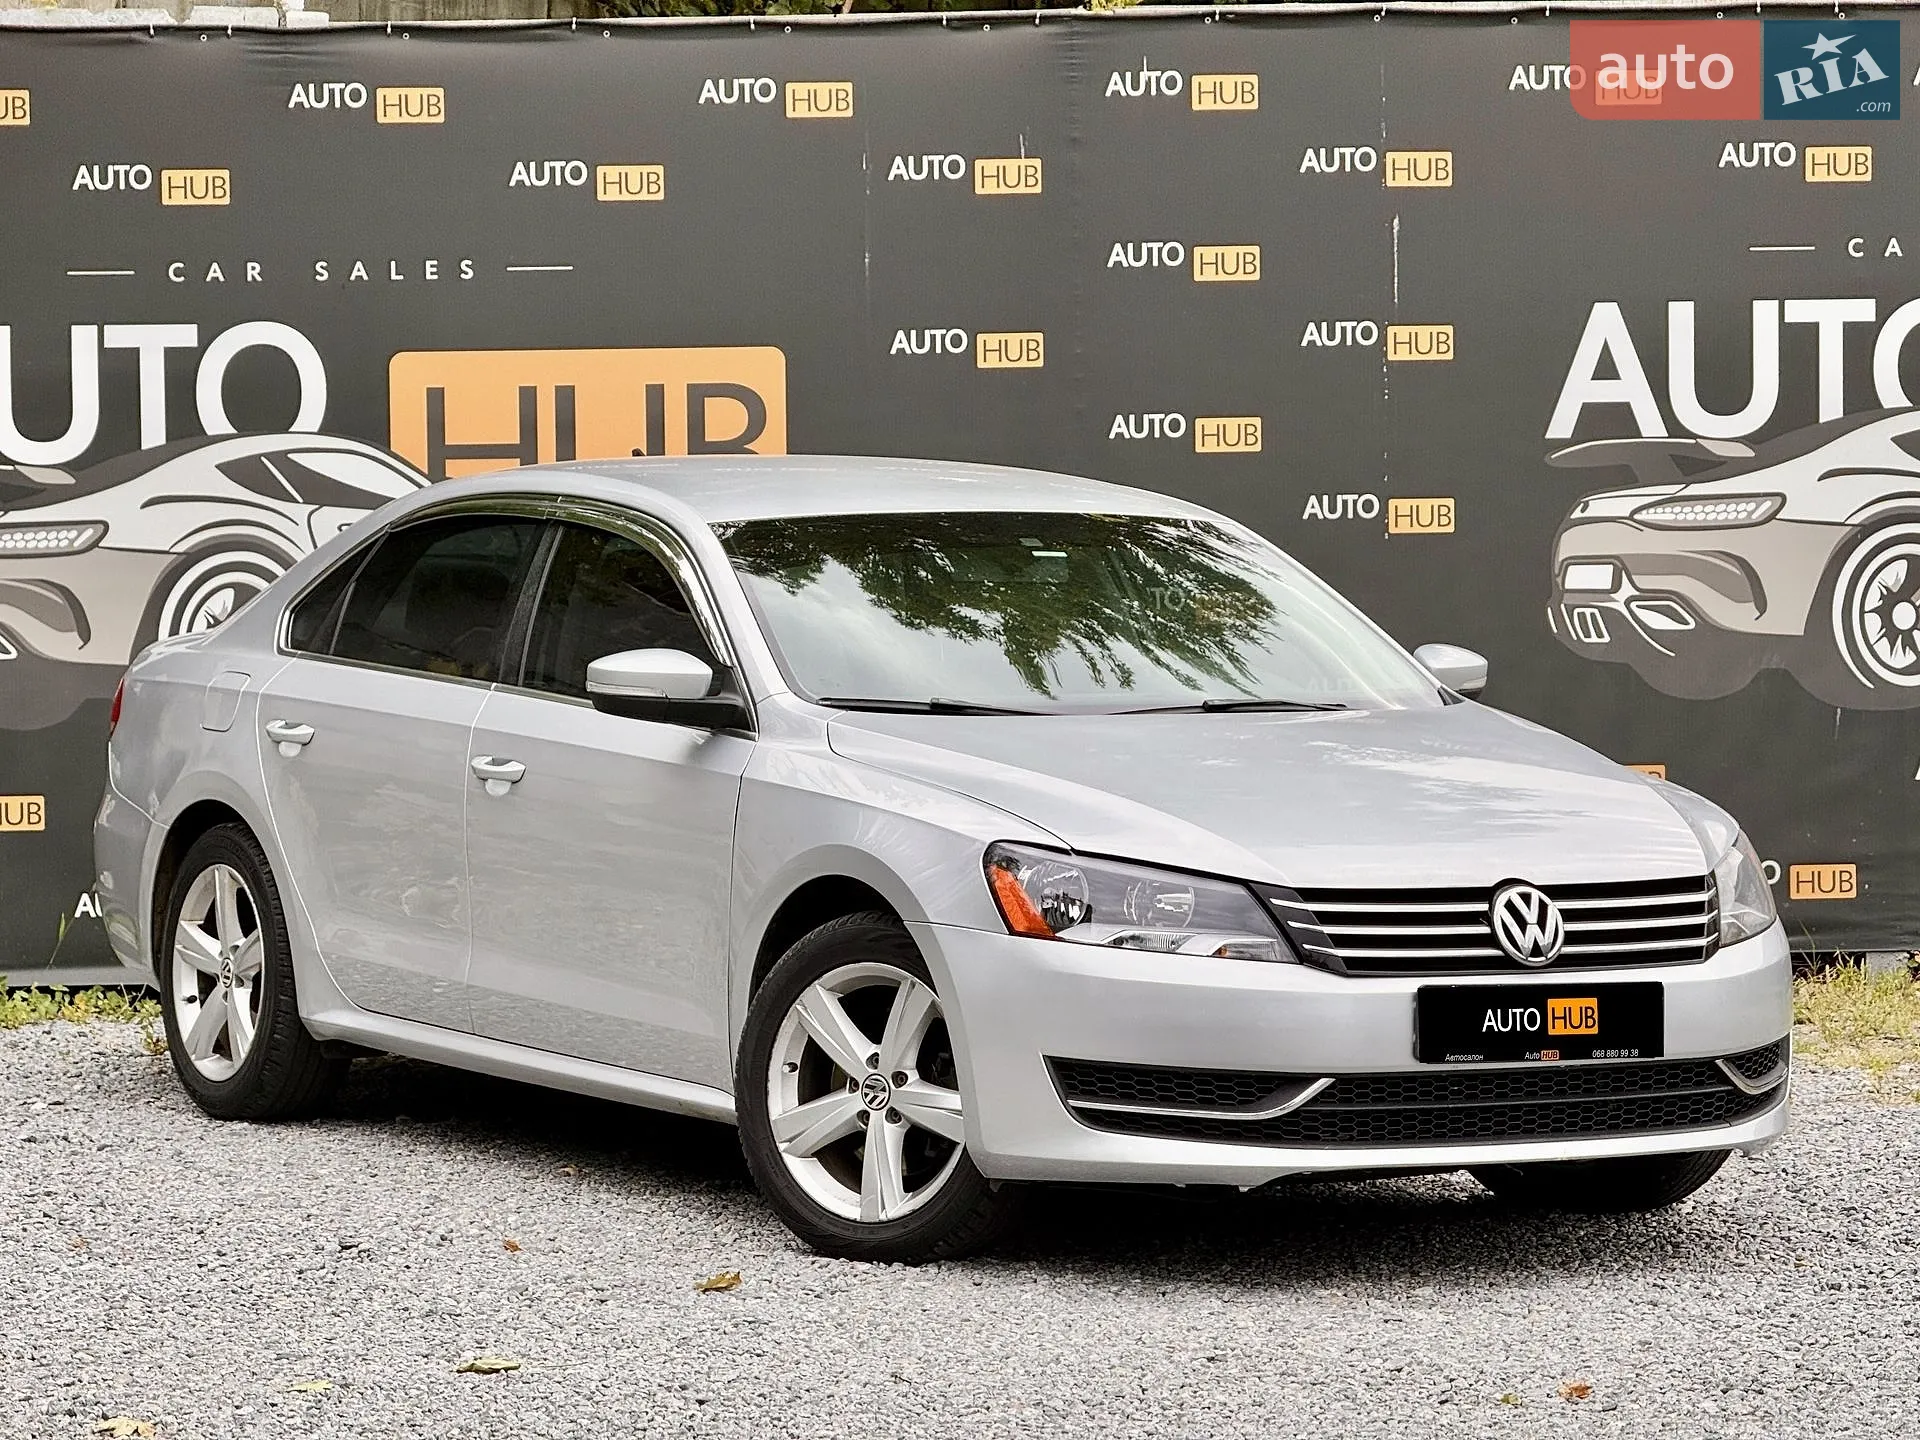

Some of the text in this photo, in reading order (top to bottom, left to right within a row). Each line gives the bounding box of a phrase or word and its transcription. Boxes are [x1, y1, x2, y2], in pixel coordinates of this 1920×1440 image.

[288, 82, 442, 118] AUTO HUB
[698, 77, 850, 113] AUTO HUB
[1105, 71, 1255, 105] AUTO HUB
[888, 154, 1039, 189] AUTO HUB
[1300, 147, 1449, 182] AUTO HUB
[1718, 142, 1869, 177] AUTO HUB
[73, 164, 227, 200] AUTO HUB
[509, 160, 661, 195] AUTO HUB
[1107, 242, 1257, 276] AUTO HUB
[1848, 237, 1903, 258] CA
[168, 259, 474, 282] CAR SALES
[890, 328, 1041, 363] AUTO HUB
[1301, 321, 1451, 355] AUTO HUB
[0, 320, 327, 465] UTO
[1108, 413, 1259, 448] AUTO HUB
[1303, 494, 1452, 528] AUTO HUB
[0, 801, 42, 825] UB
[1796, 869, 1854, 894] HUB
[1482, 1006, 1597, 1033] AUTO HUB
[1524, 1051, 1559, 1060] Auto HUB
[1592, 1048, 1639, 1058] 068 880 99 38
